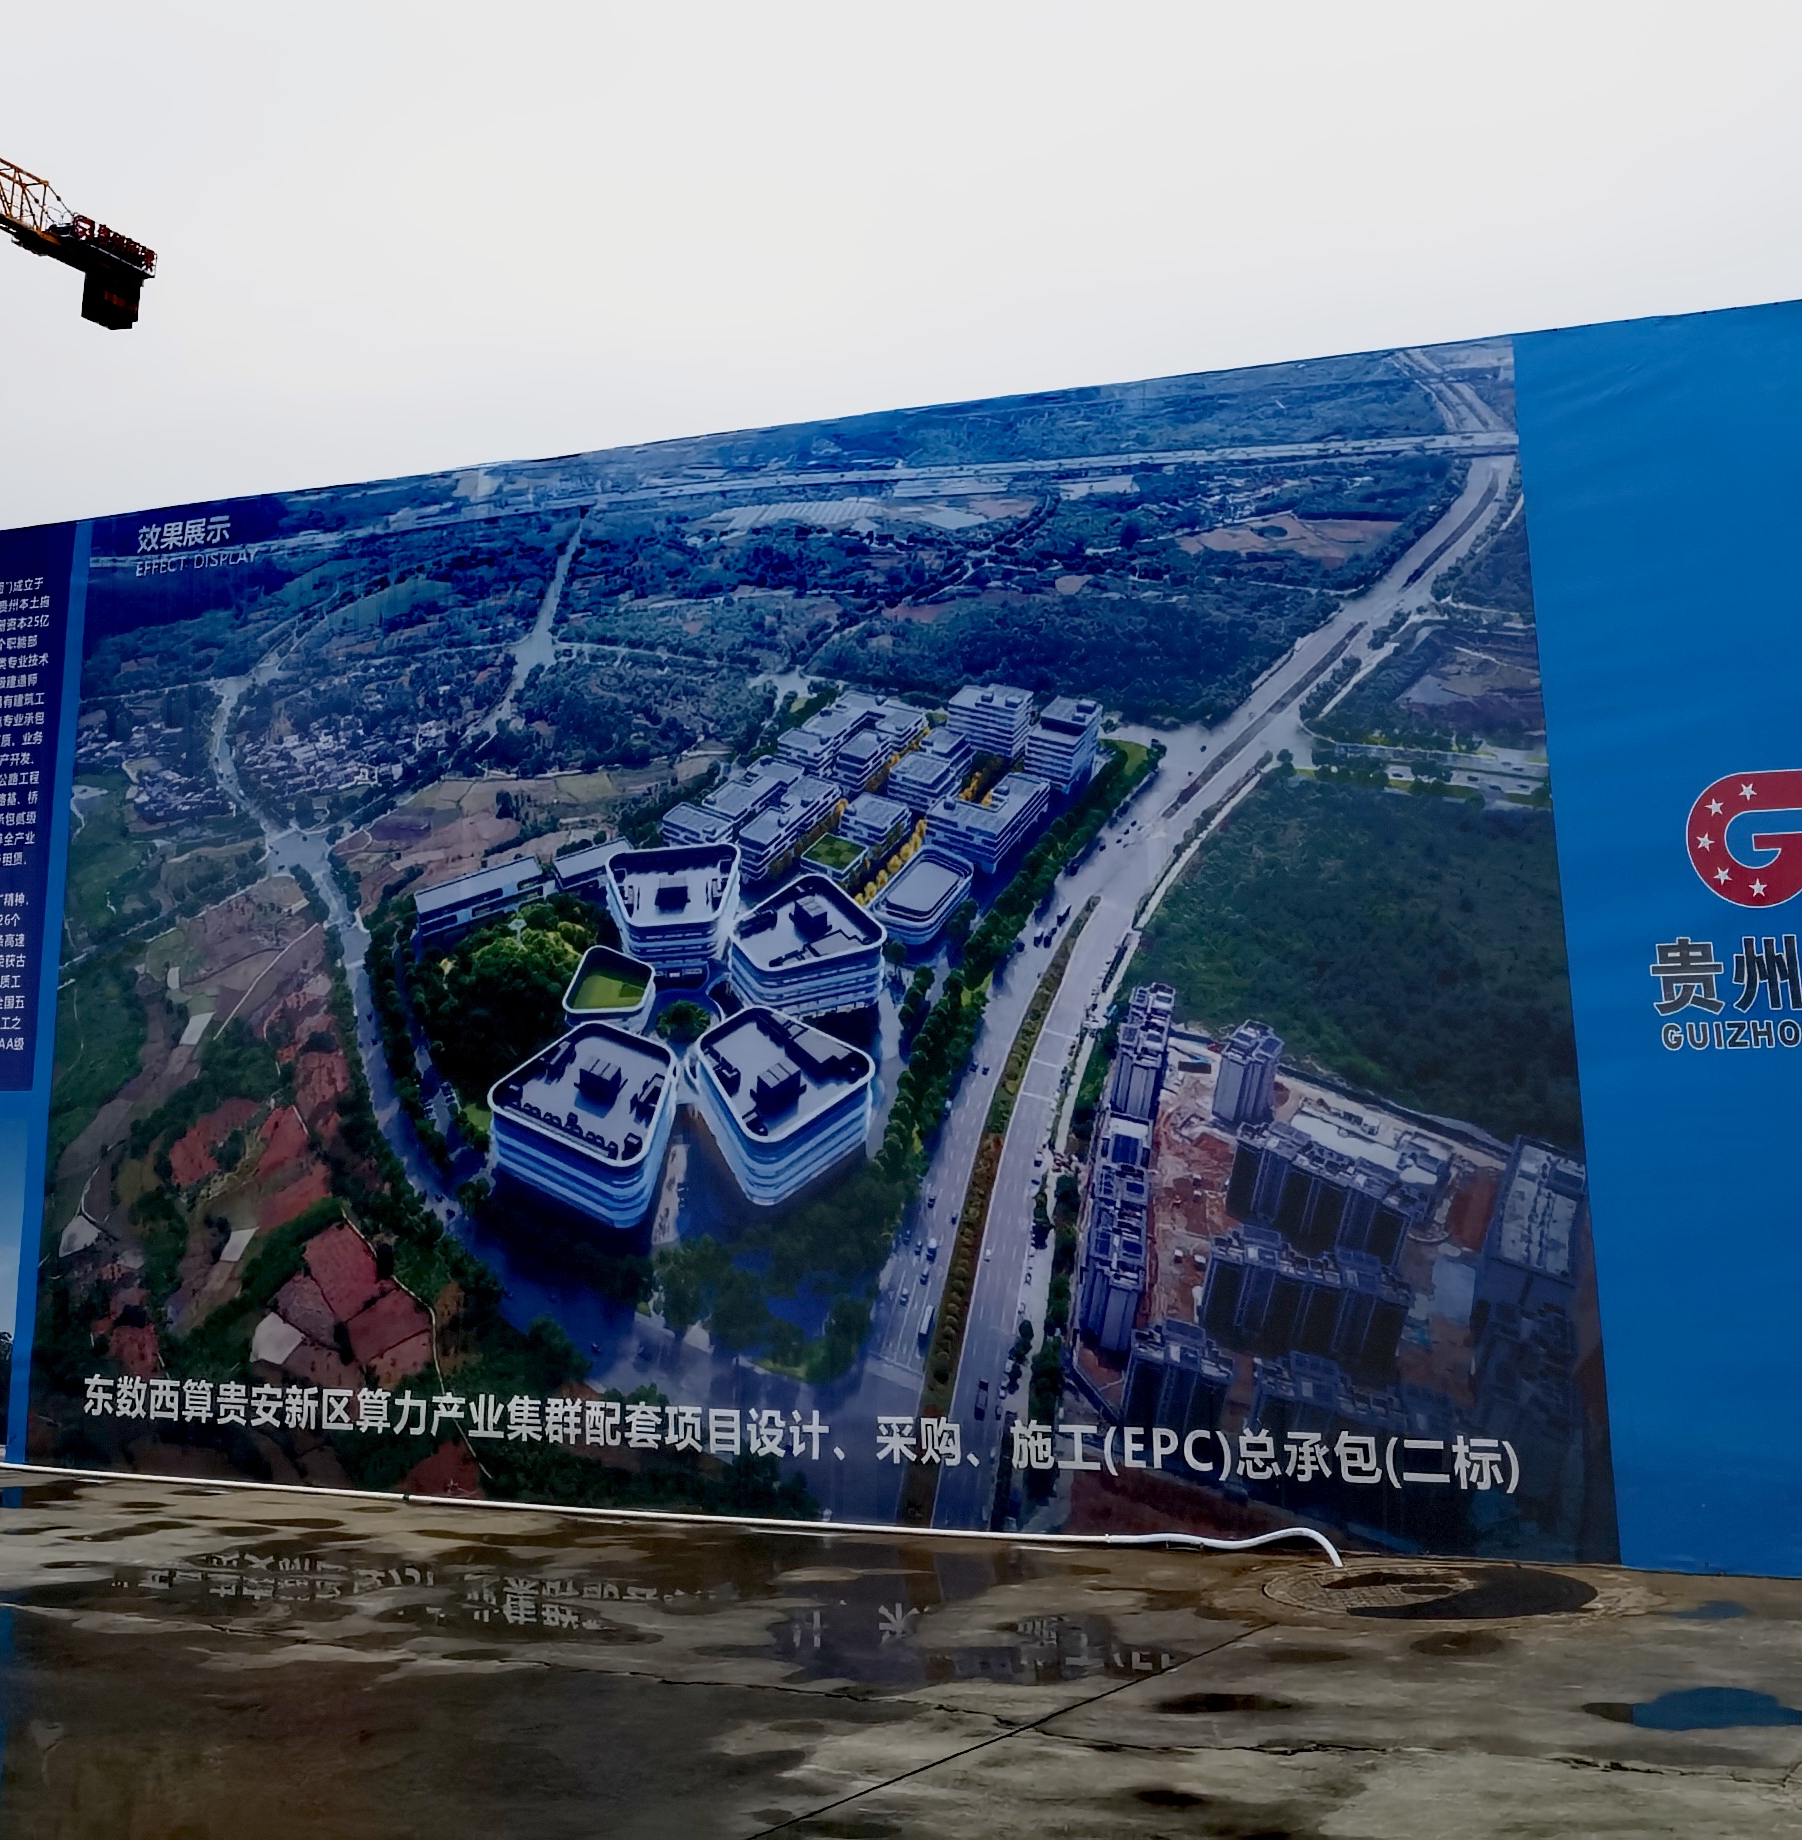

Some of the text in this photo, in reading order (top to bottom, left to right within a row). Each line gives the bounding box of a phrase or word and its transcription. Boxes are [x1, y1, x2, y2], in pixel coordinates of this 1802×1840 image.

[137, 515, 230, 554] 效果展示
[136, 548, 259, 577] EFFECT DISPLAY
